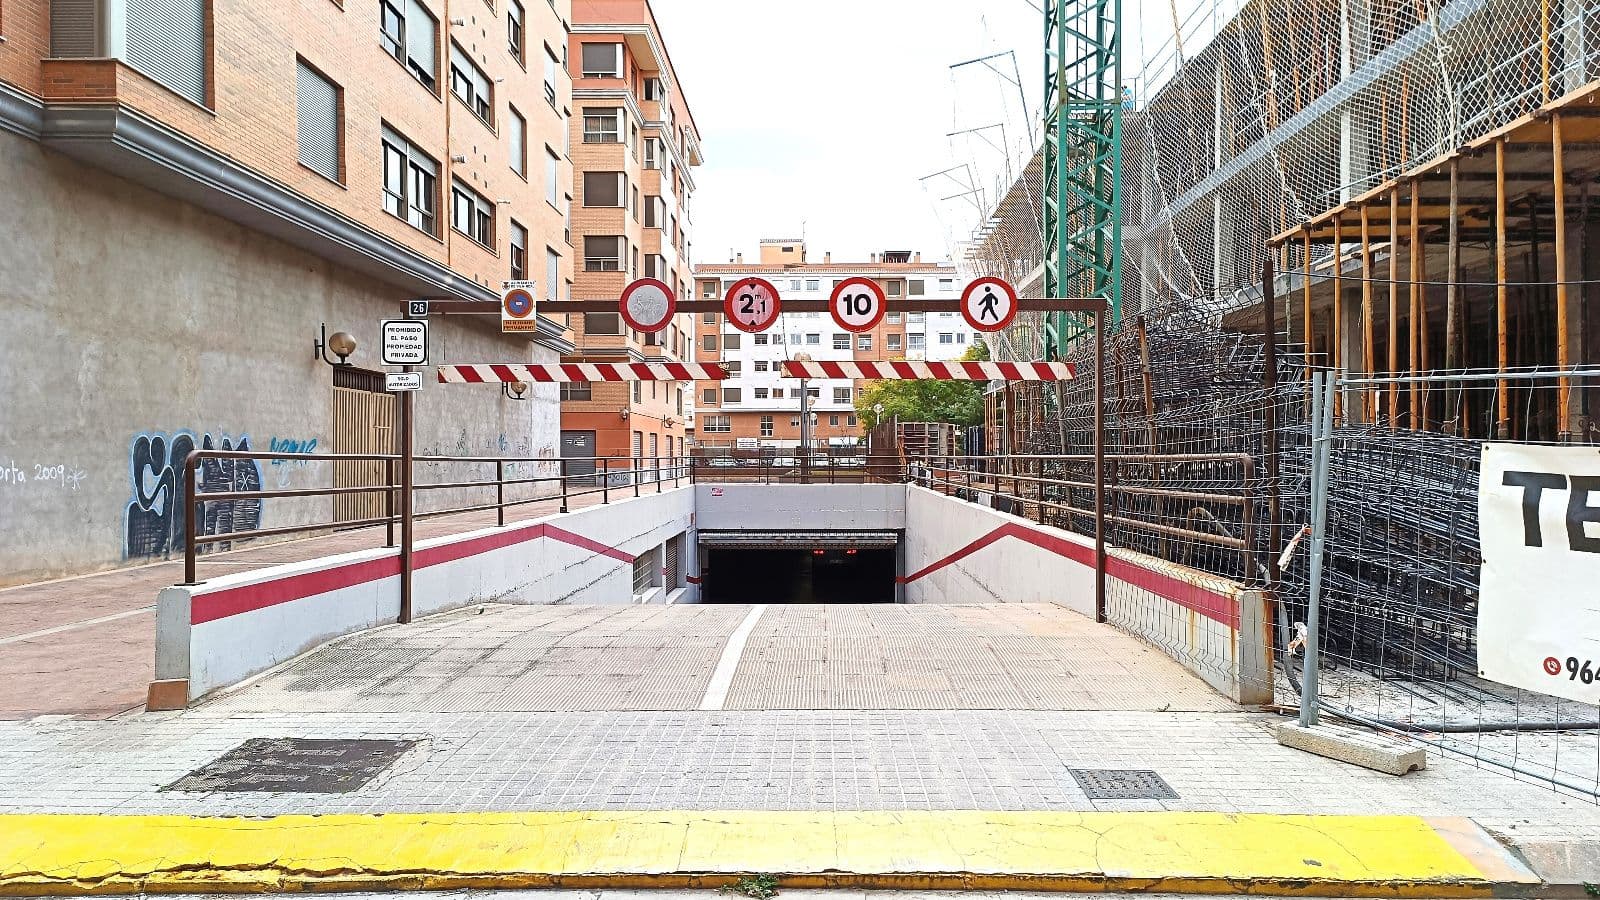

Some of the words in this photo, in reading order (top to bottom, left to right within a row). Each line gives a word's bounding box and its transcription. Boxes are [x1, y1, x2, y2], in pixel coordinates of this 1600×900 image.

[413, 303, 425, 313] 26
[843, 294, 872, 315] 10
[34, 463, 64, 488] 2009
